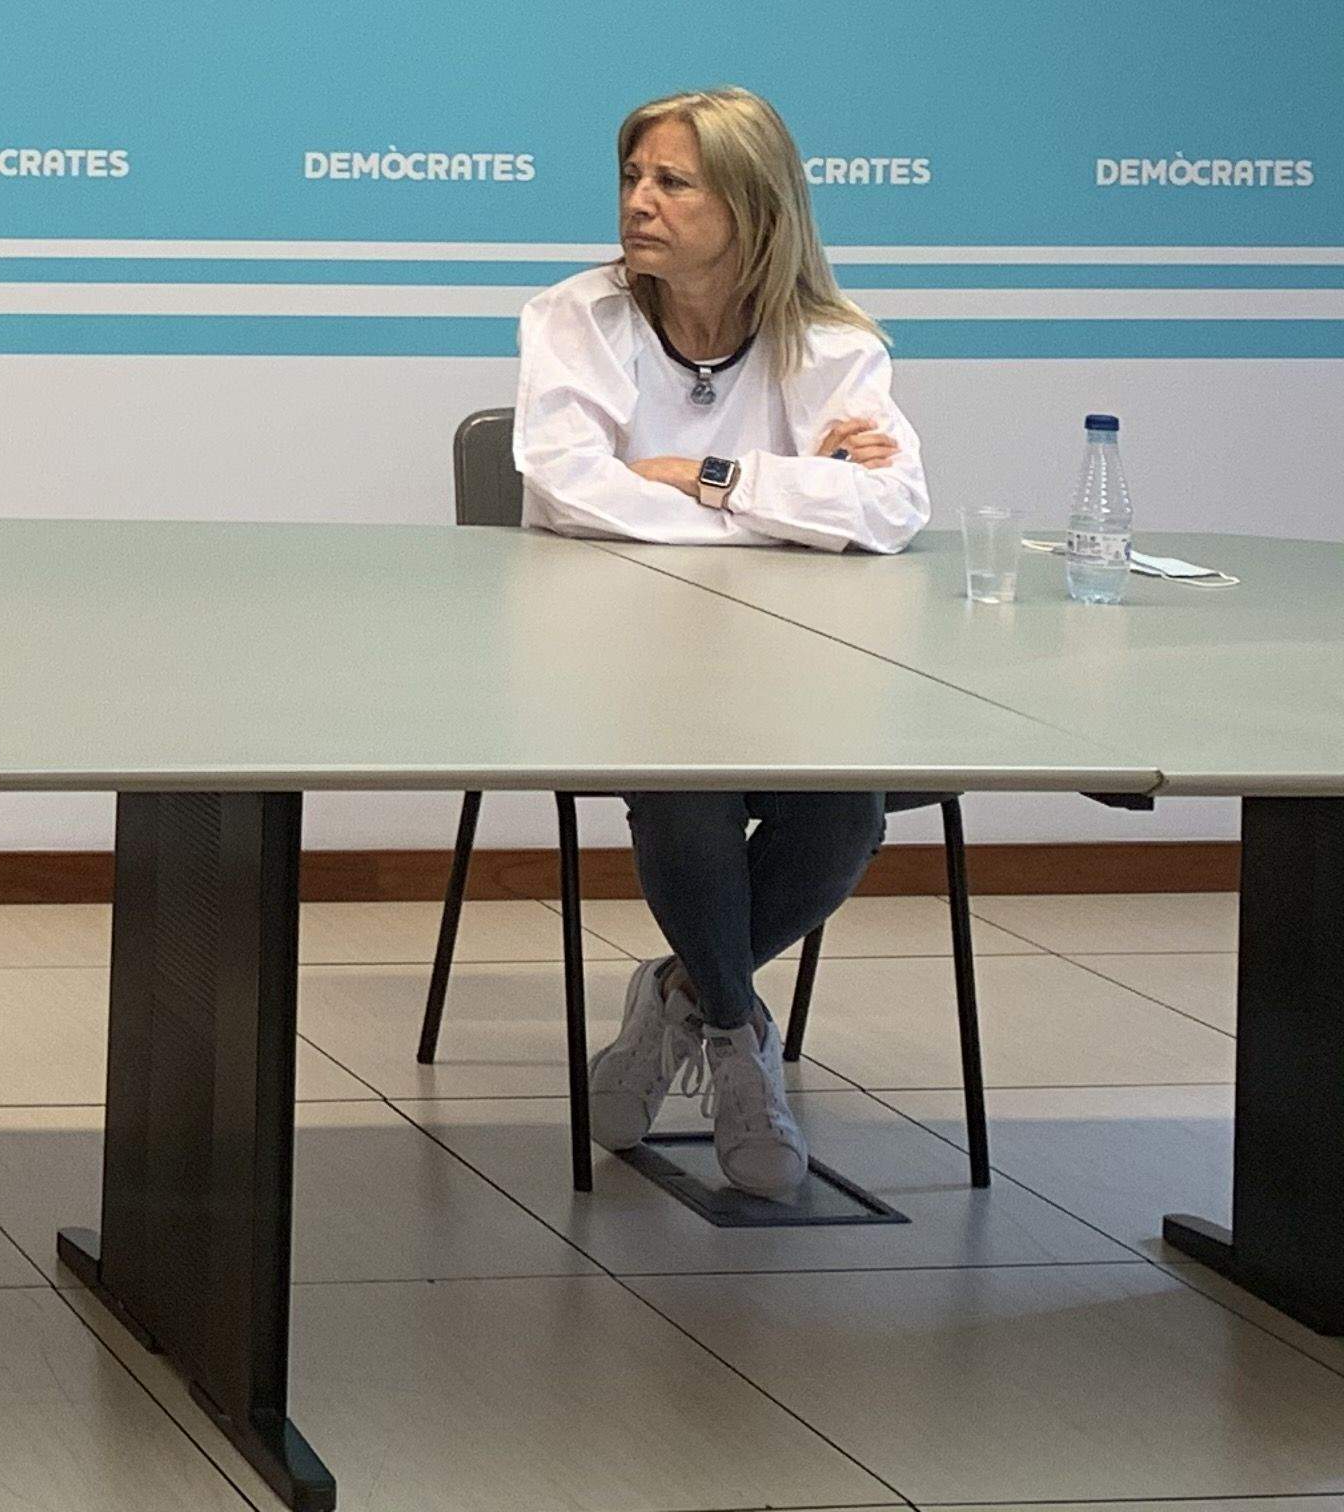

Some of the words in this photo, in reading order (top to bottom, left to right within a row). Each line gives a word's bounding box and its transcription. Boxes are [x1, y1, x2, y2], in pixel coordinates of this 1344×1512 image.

[303, 143, 536, 182] DEMÒCRATES
[801, 156, 931, 186] CRATES
[1095, 150, 1314, 187] DEMÒCRATES
